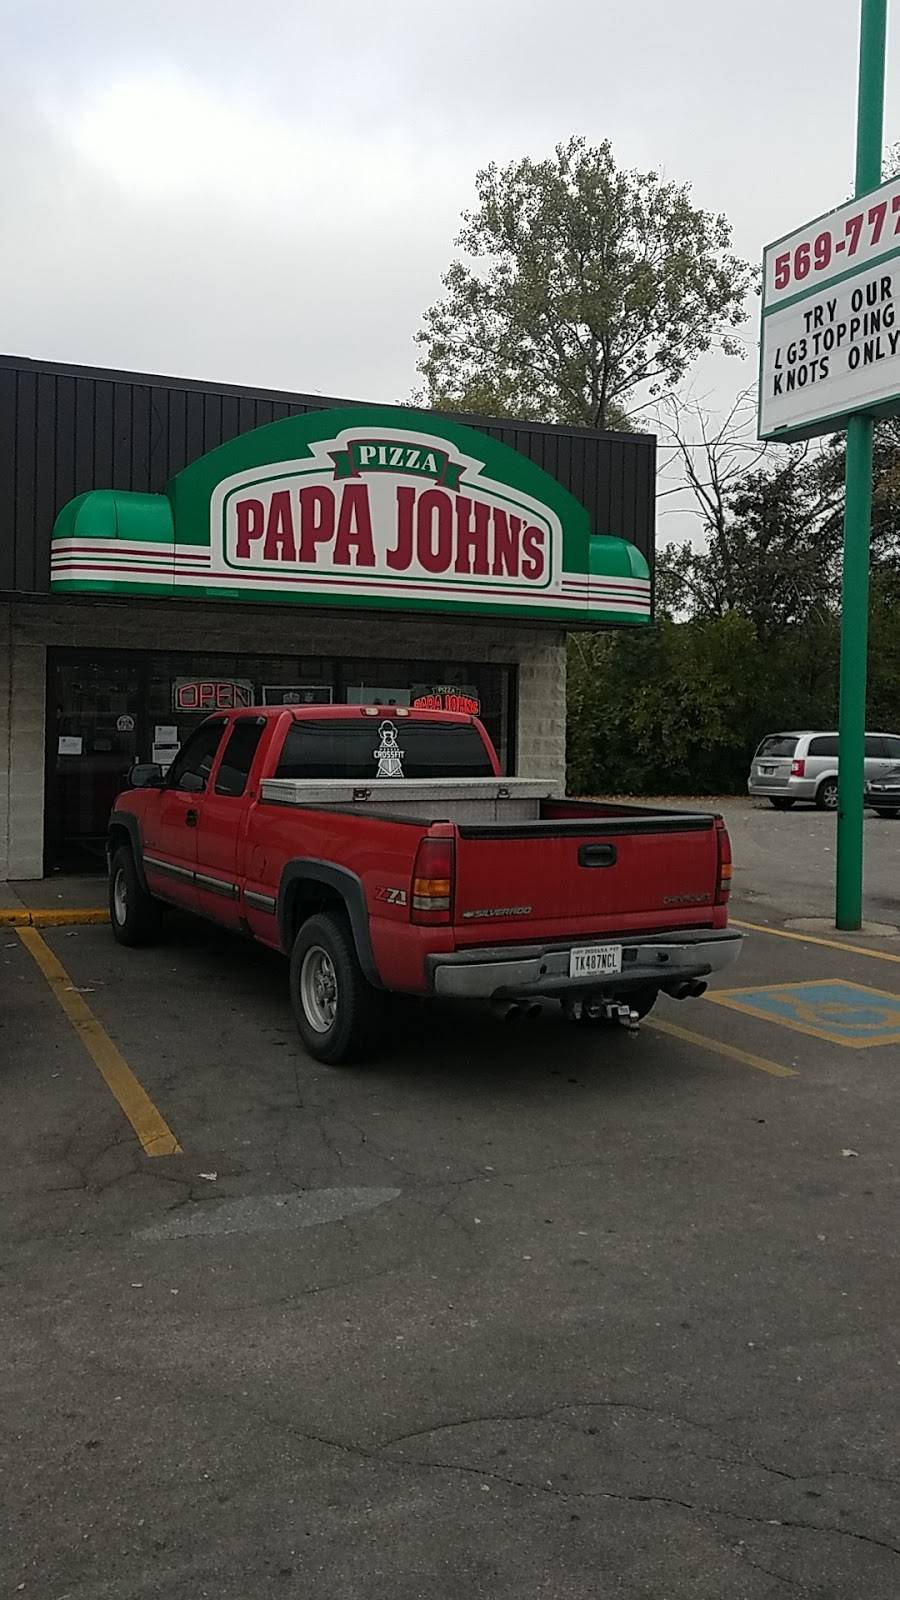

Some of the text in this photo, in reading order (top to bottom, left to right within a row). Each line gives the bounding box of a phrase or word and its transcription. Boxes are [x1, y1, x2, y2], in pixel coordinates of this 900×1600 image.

[803, 276, 892, 334] TRY OUR
[773, 329, 900, 396] KNOTS ONLY
[358, 445, 438, 473] PIZZA
[235, 483, 545, 580] PAPA JOHN'S
[180, 683, 250, 708] OPEN
[373, 750, 405, 759] CROSSFIT
[375, 885, 408, 906] Z71
[574, 952, 617, 971] TK487NCL
